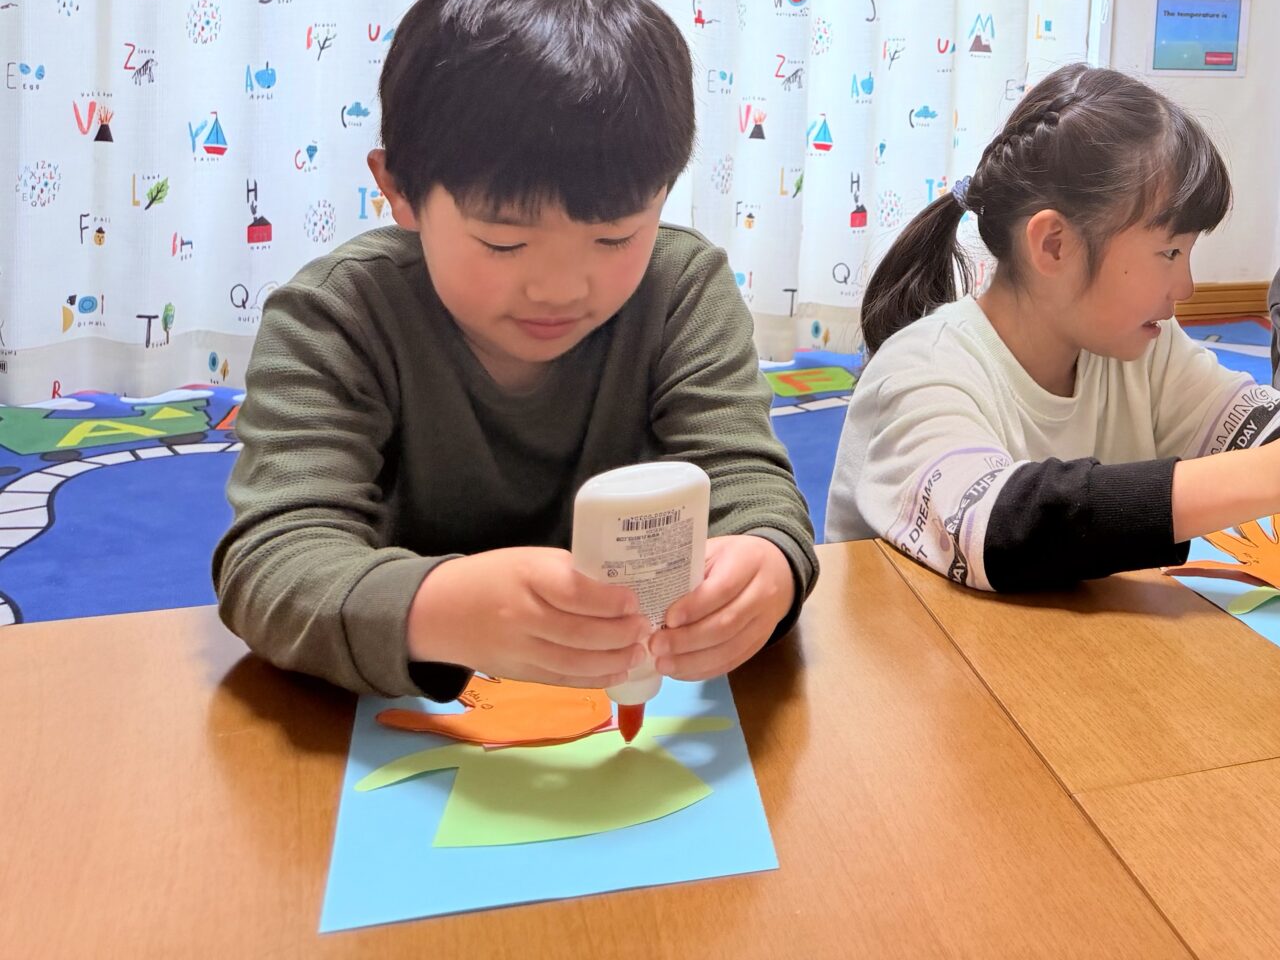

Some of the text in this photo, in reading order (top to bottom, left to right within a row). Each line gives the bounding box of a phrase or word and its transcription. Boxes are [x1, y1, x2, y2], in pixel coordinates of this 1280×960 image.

[123, 42, 136, 71] Z
[6, 61, 17, 90] E
[72, 100, 97, 135] V
[188, 120, 208, 154] Y
[1236, 419, 1258, 448] DAY
[908, 469, 943, 544] DREAMS
